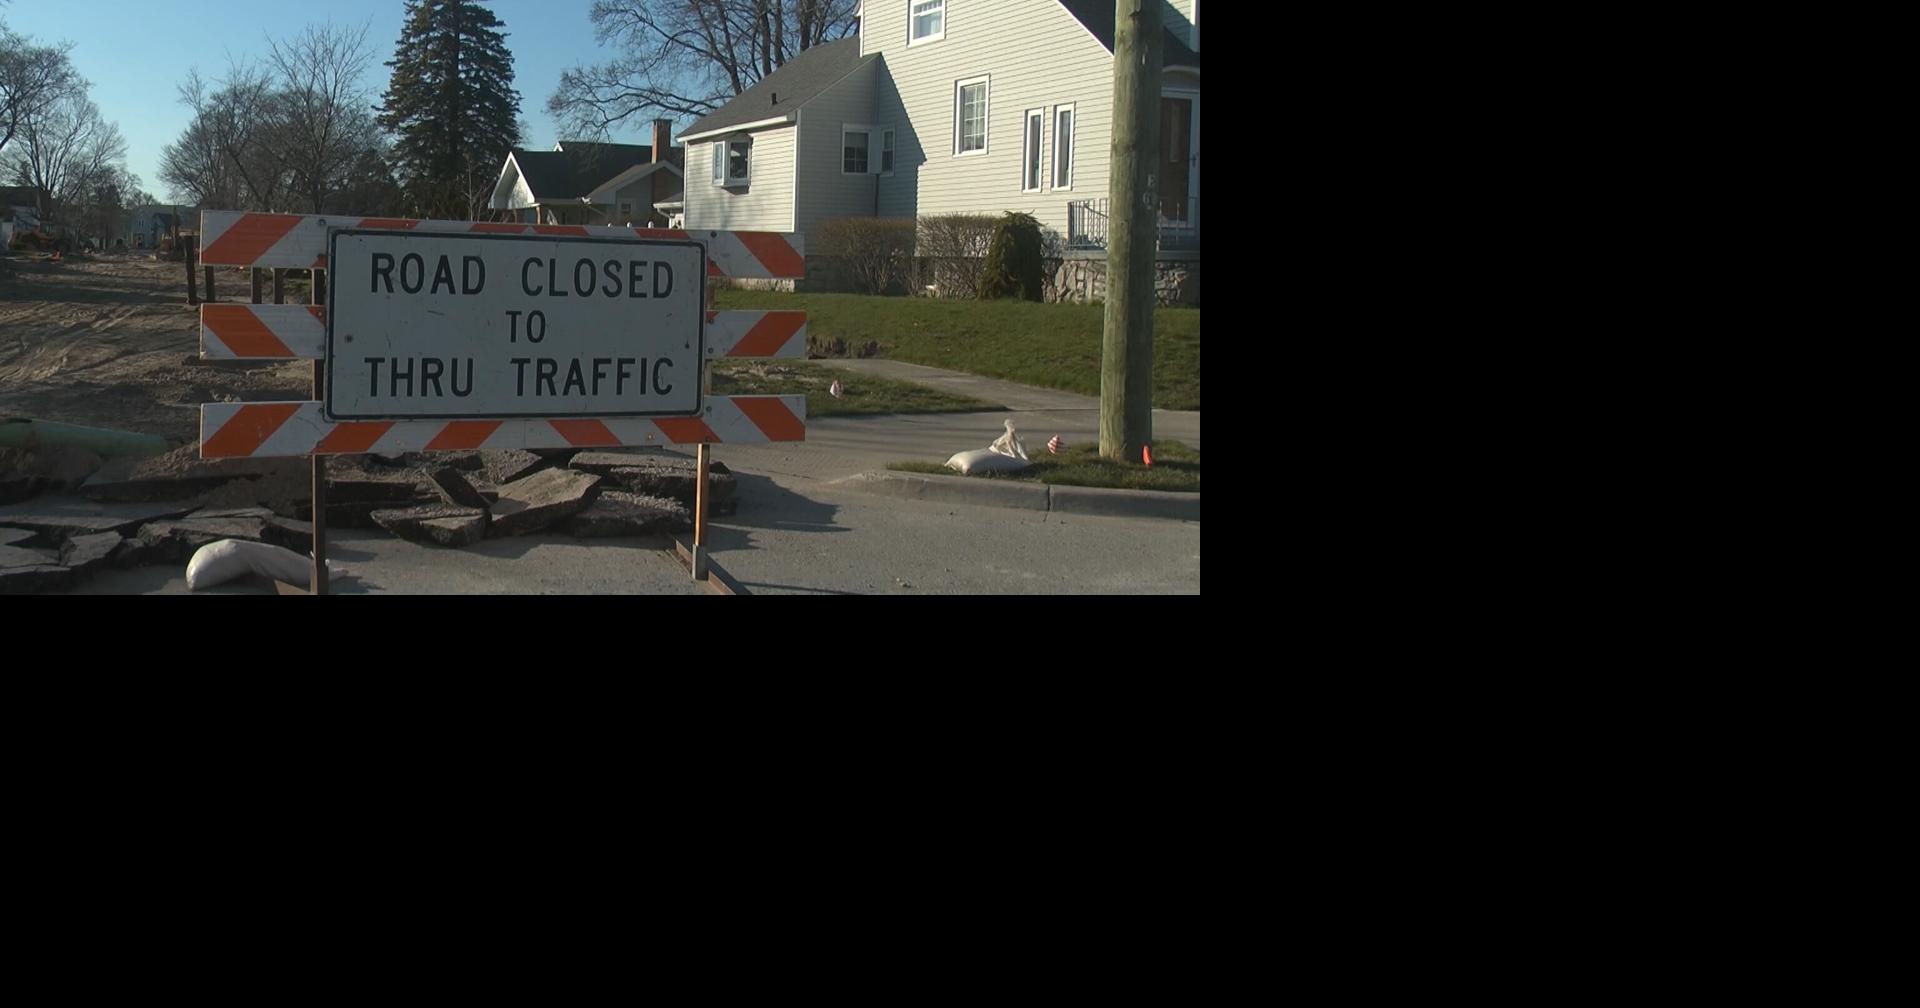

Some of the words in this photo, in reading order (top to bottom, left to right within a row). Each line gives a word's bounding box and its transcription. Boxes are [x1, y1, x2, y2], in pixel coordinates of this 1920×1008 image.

[370, 252, 486, 295] ROAD
[521, 257, 674, 298] CLOSED
[505, 310, 546, 343] TO
[364, 357, 474, 397] THRU
[510, 357, 674, 397] TRAFFIC
